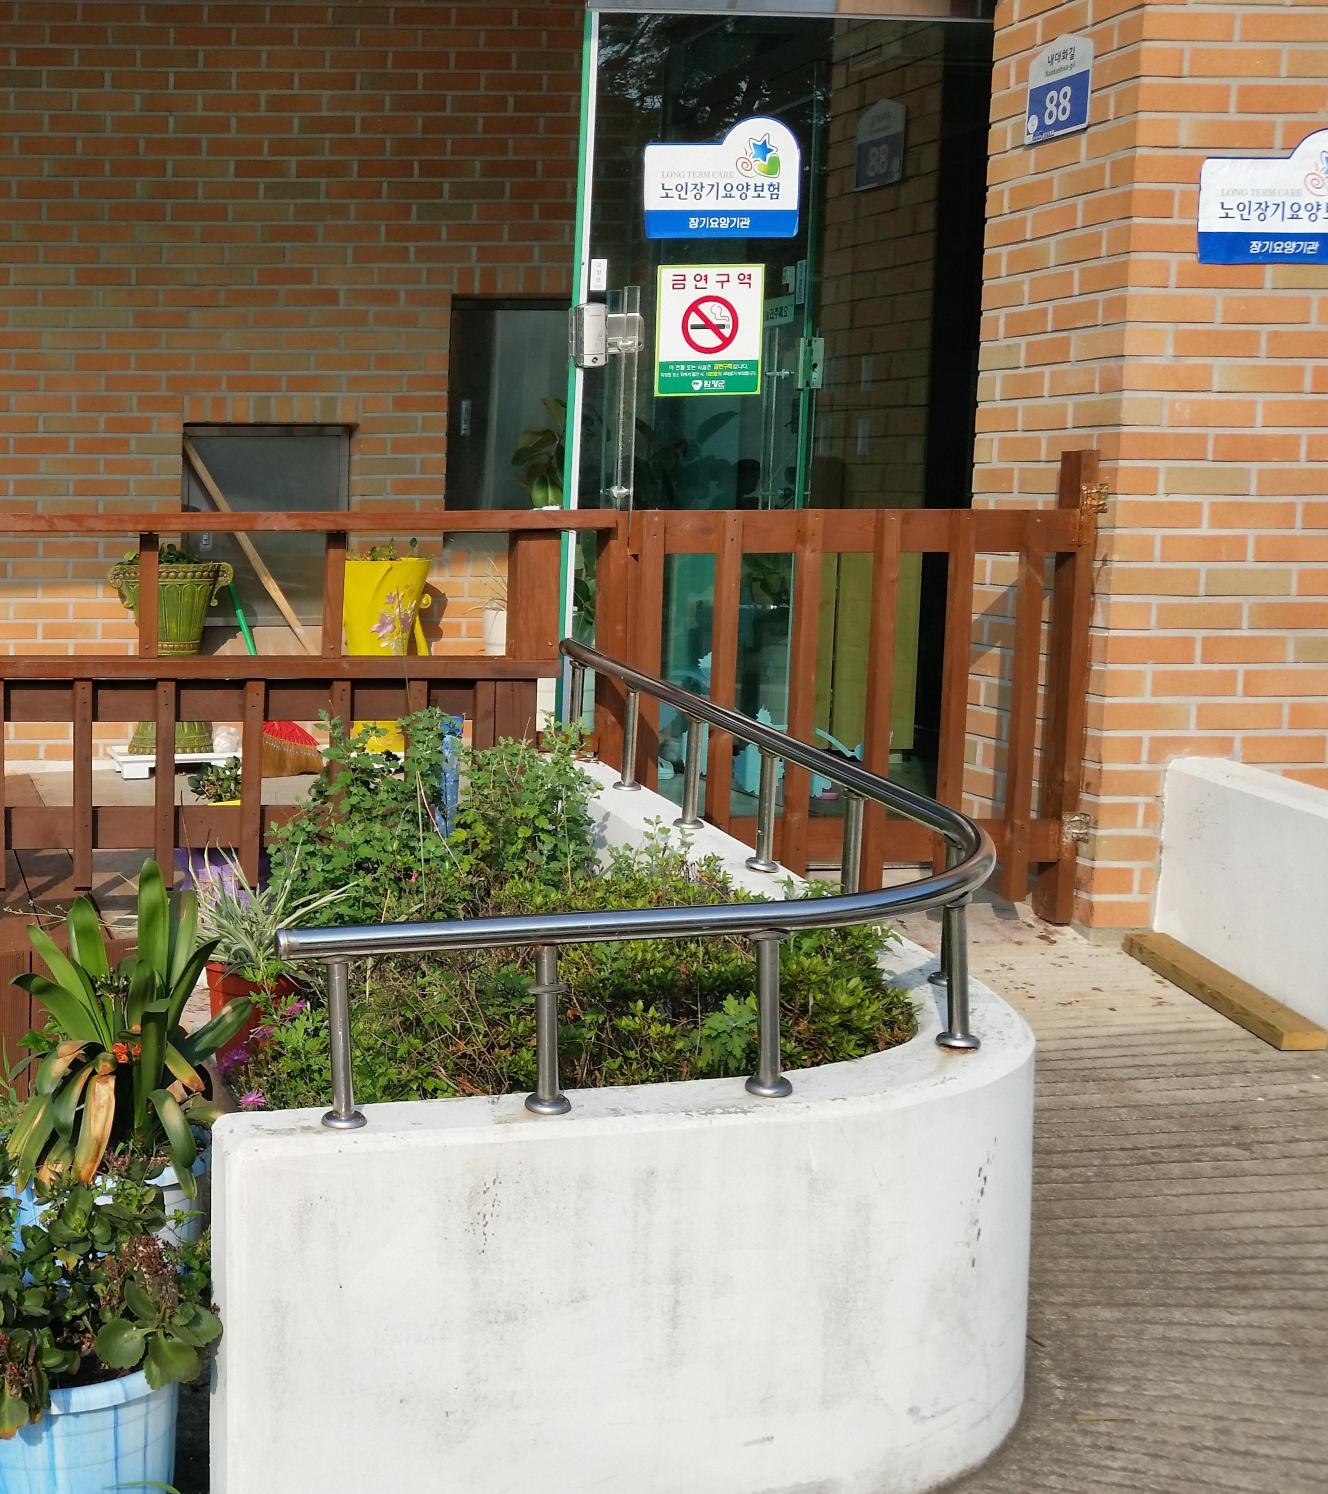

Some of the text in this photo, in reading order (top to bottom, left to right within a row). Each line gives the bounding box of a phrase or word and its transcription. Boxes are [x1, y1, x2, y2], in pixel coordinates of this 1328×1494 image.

[1044, 86, 1072, 125] 88
[661, 171, 735, 179] LONG TERM CARE
[659, 181, 781, 201] 노인장기요양보험
[1220, 188, 1249, 197] LONG
[688, 217, 750, 229] 장기요양기관
[1249, 240, 1320, 254] 장기요양기관
[671, 273, 752, 290] 금연구역
